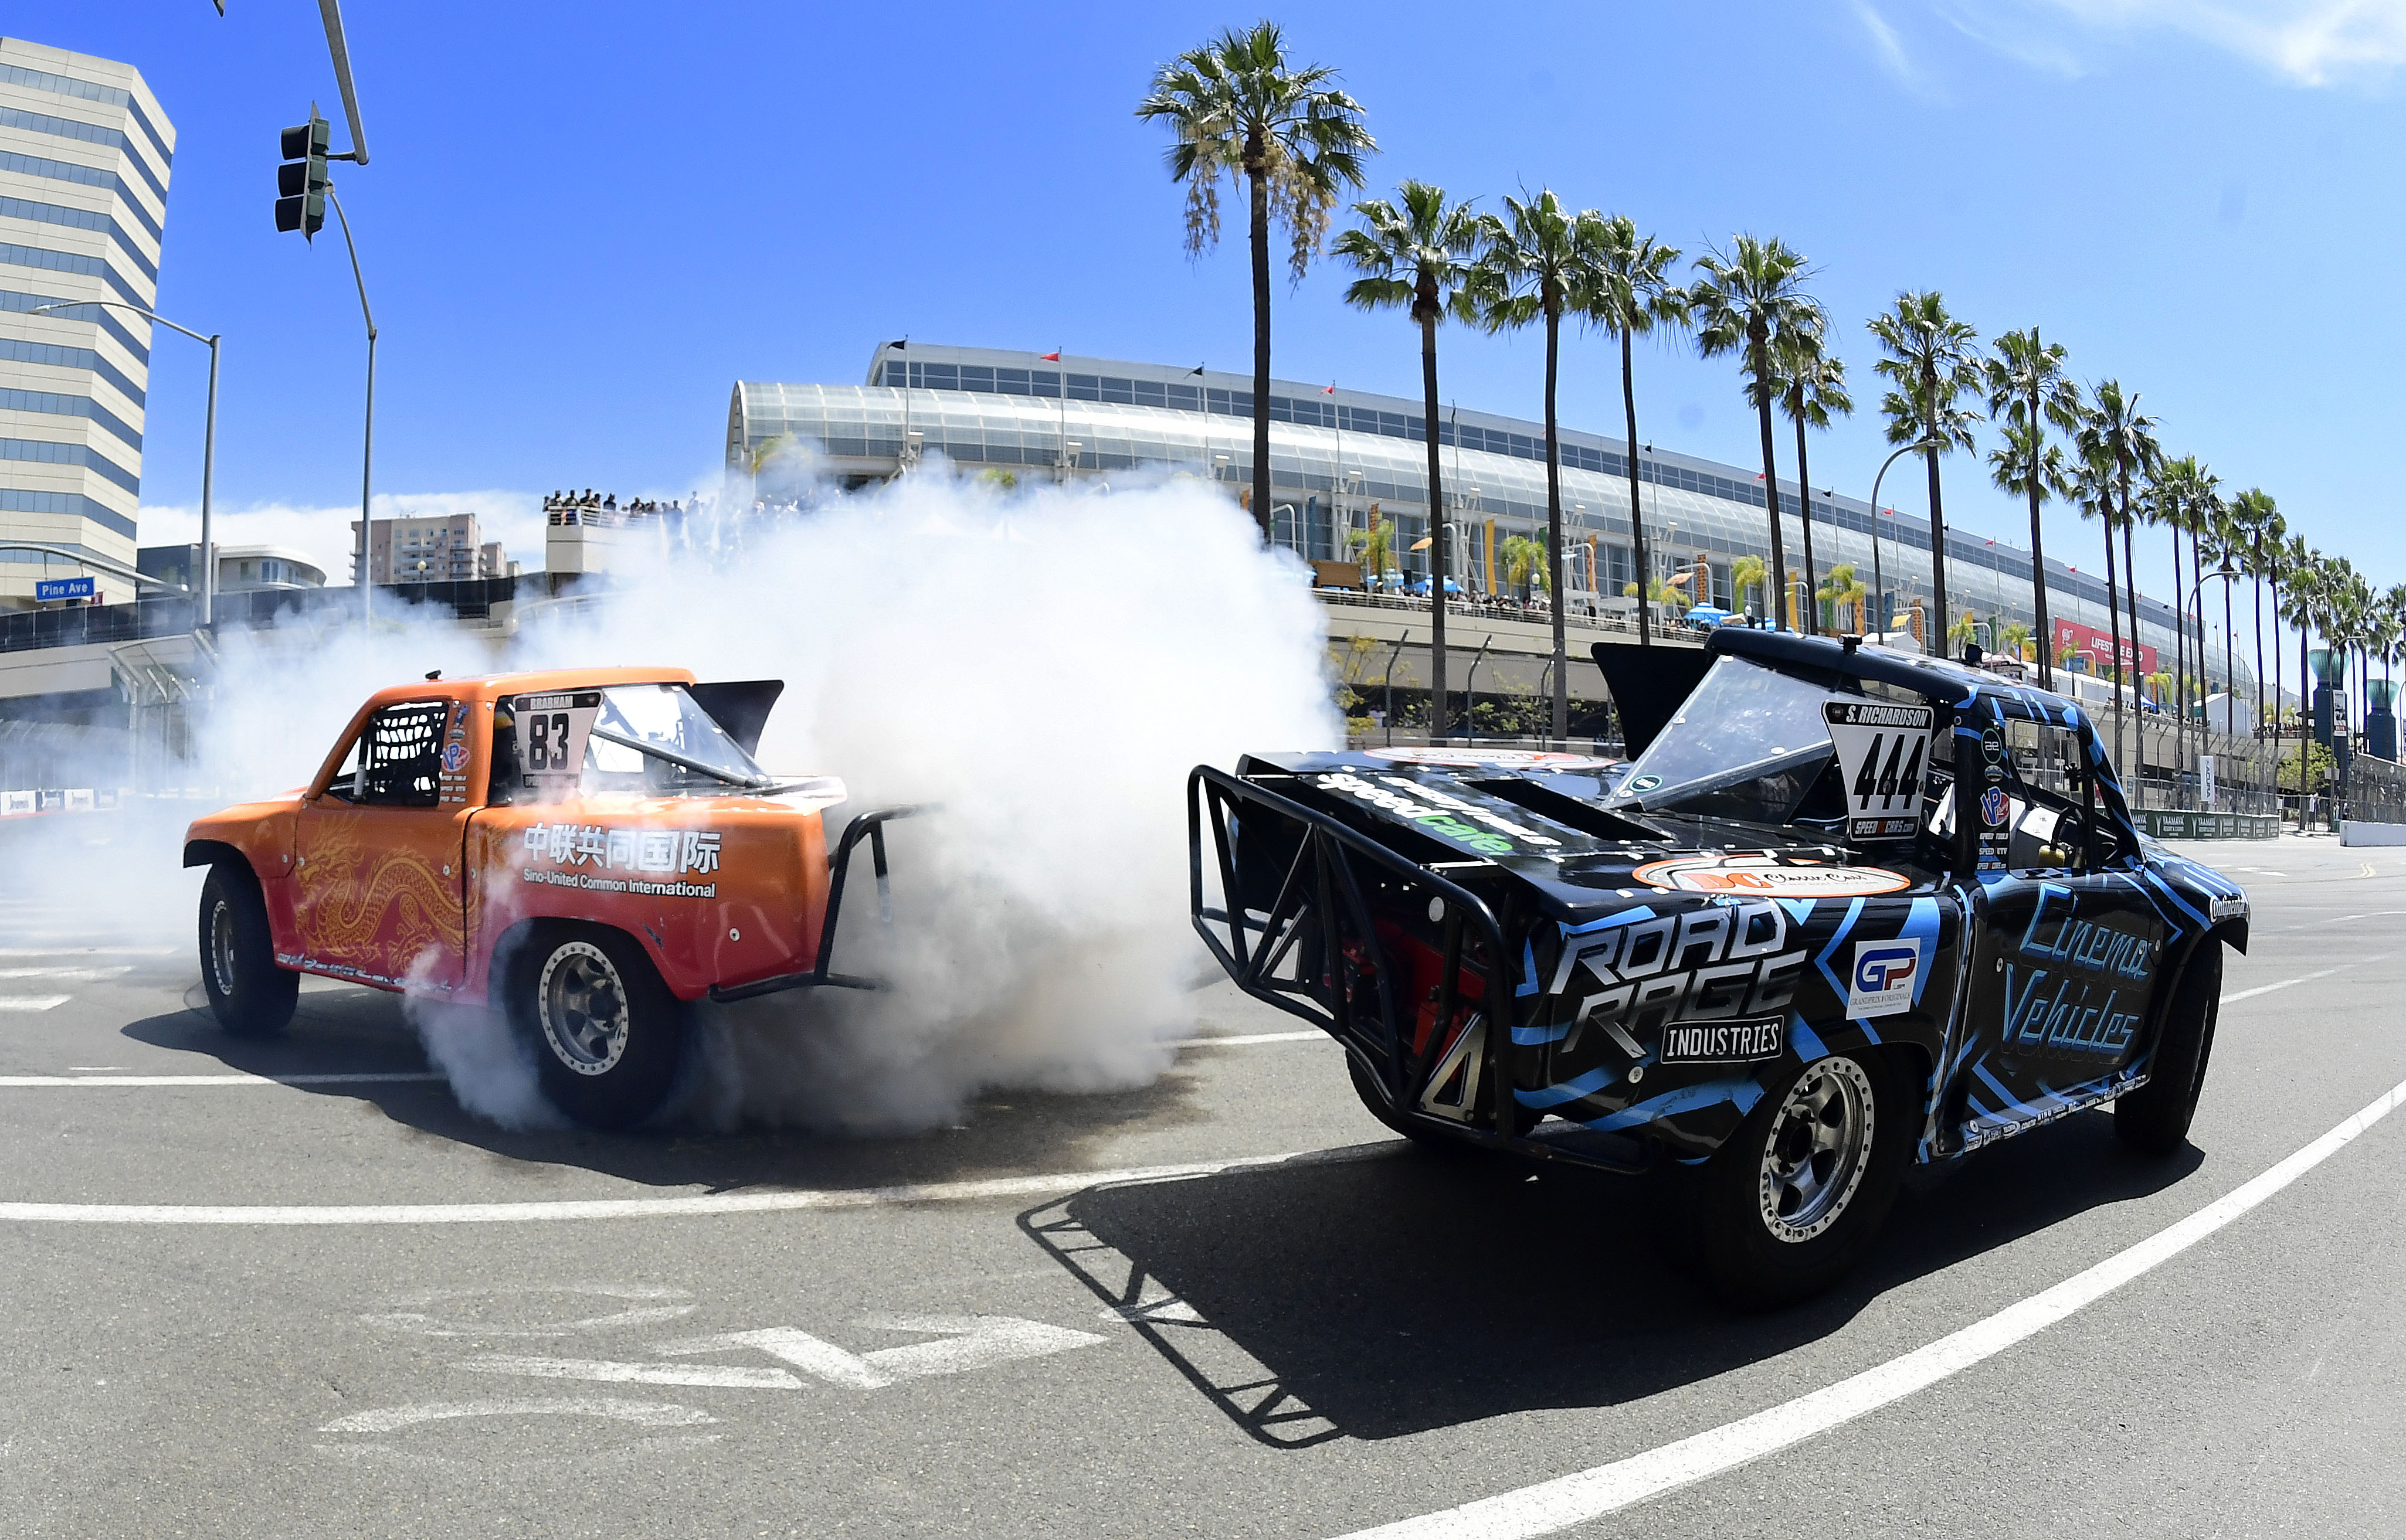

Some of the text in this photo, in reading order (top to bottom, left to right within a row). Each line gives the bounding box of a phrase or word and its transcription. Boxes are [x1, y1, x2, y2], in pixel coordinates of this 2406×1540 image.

[42, 583, 88, 596] Pine Ave
[2092, 637, 2125, 656] LIFESTE
[1846, 705, 1928, 727] S. RICHARDSON
[442, 743, 460, 770] VP
[529, 713, 569, 770] 83
[1854, 733, 1926, 810] 444
[1980, 786, 2001, 825] VP
[524, 822, 722, 874] 中联共同国际
[524, 868, 716, 898] Sino-United Common International
[1680, 873, 1774, 889] DC
[1549, 902, 1787, 995] ROAD
[2020, 880, 2153, 981] Cinema
[1855, 947, 1916, 992] GP
[1560, 950, 1807, 1059] RAGE
[2003, 962, 2140, 1055] Vehicles
[1667, 1023, 1779, 1057] INDUSTRIES
